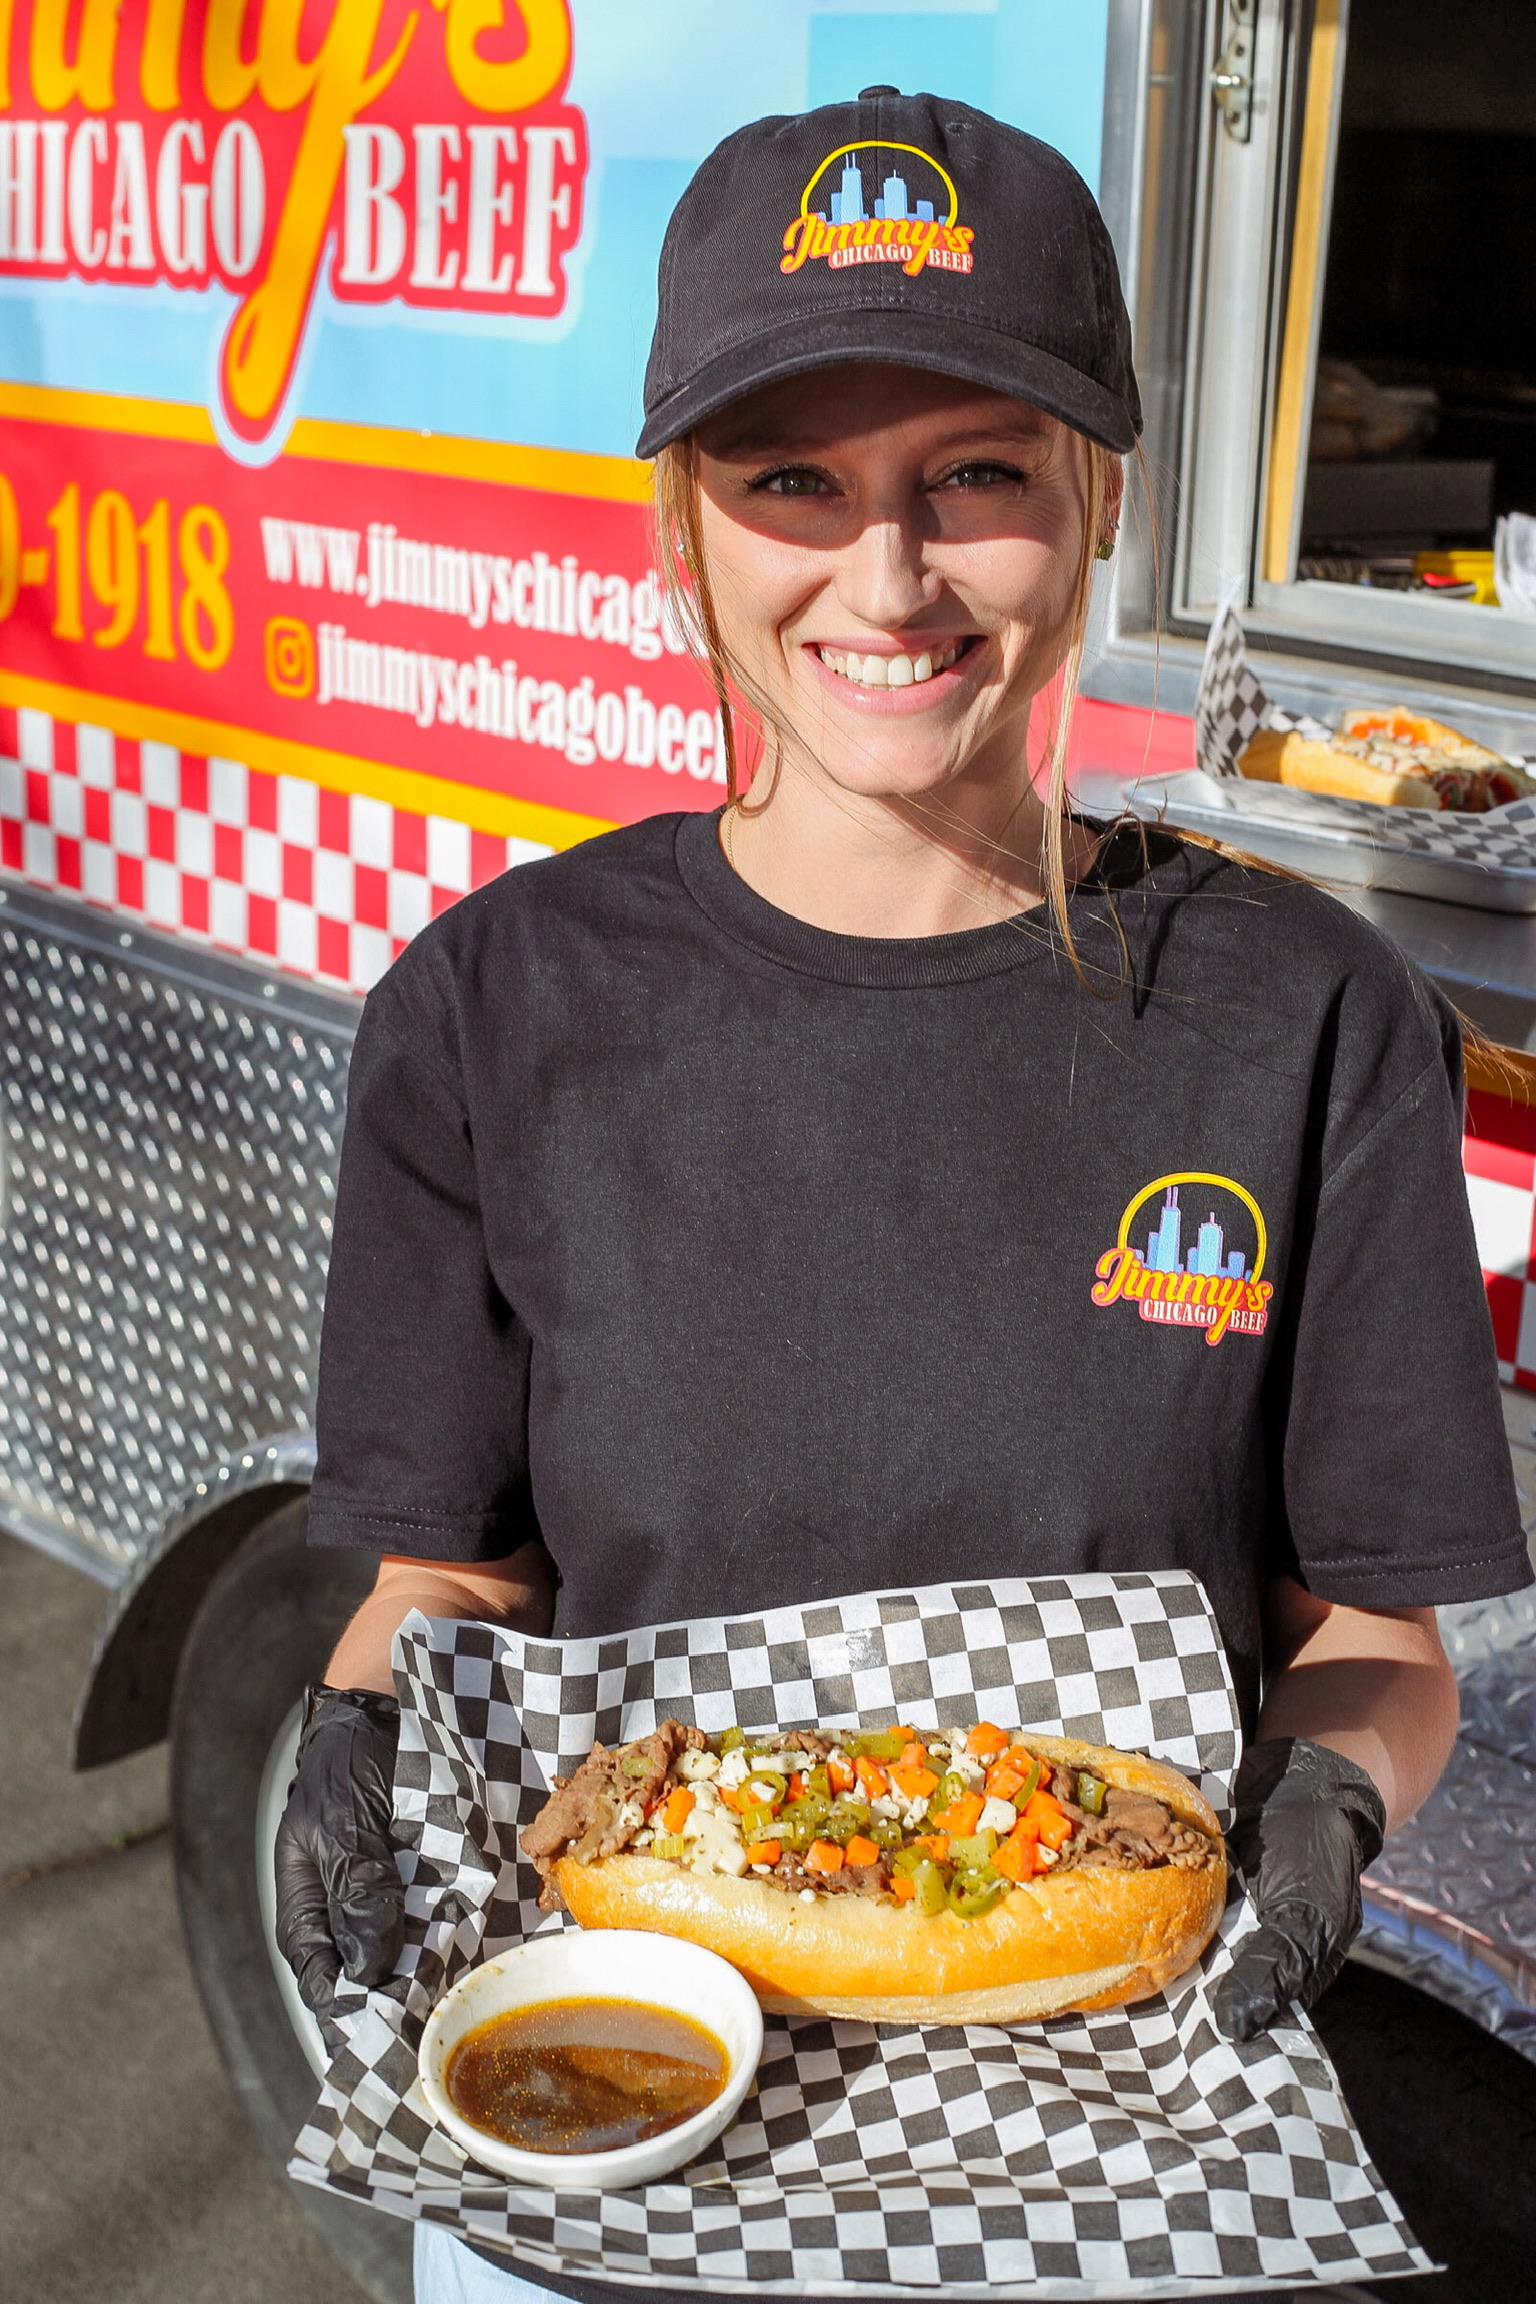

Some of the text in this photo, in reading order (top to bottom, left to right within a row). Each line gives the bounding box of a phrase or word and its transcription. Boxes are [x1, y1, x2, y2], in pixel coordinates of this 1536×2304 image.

[338, 122, 577, 297] BEEF
[781, 212, 974, 275] Jimmy's
[832, 243, 972, 272] CHICAGO BEEF
[1093, 1249, 1272, 1343] Jimmy's
[1142, 1299, 1265, 1332] CHICAGO BEEF
